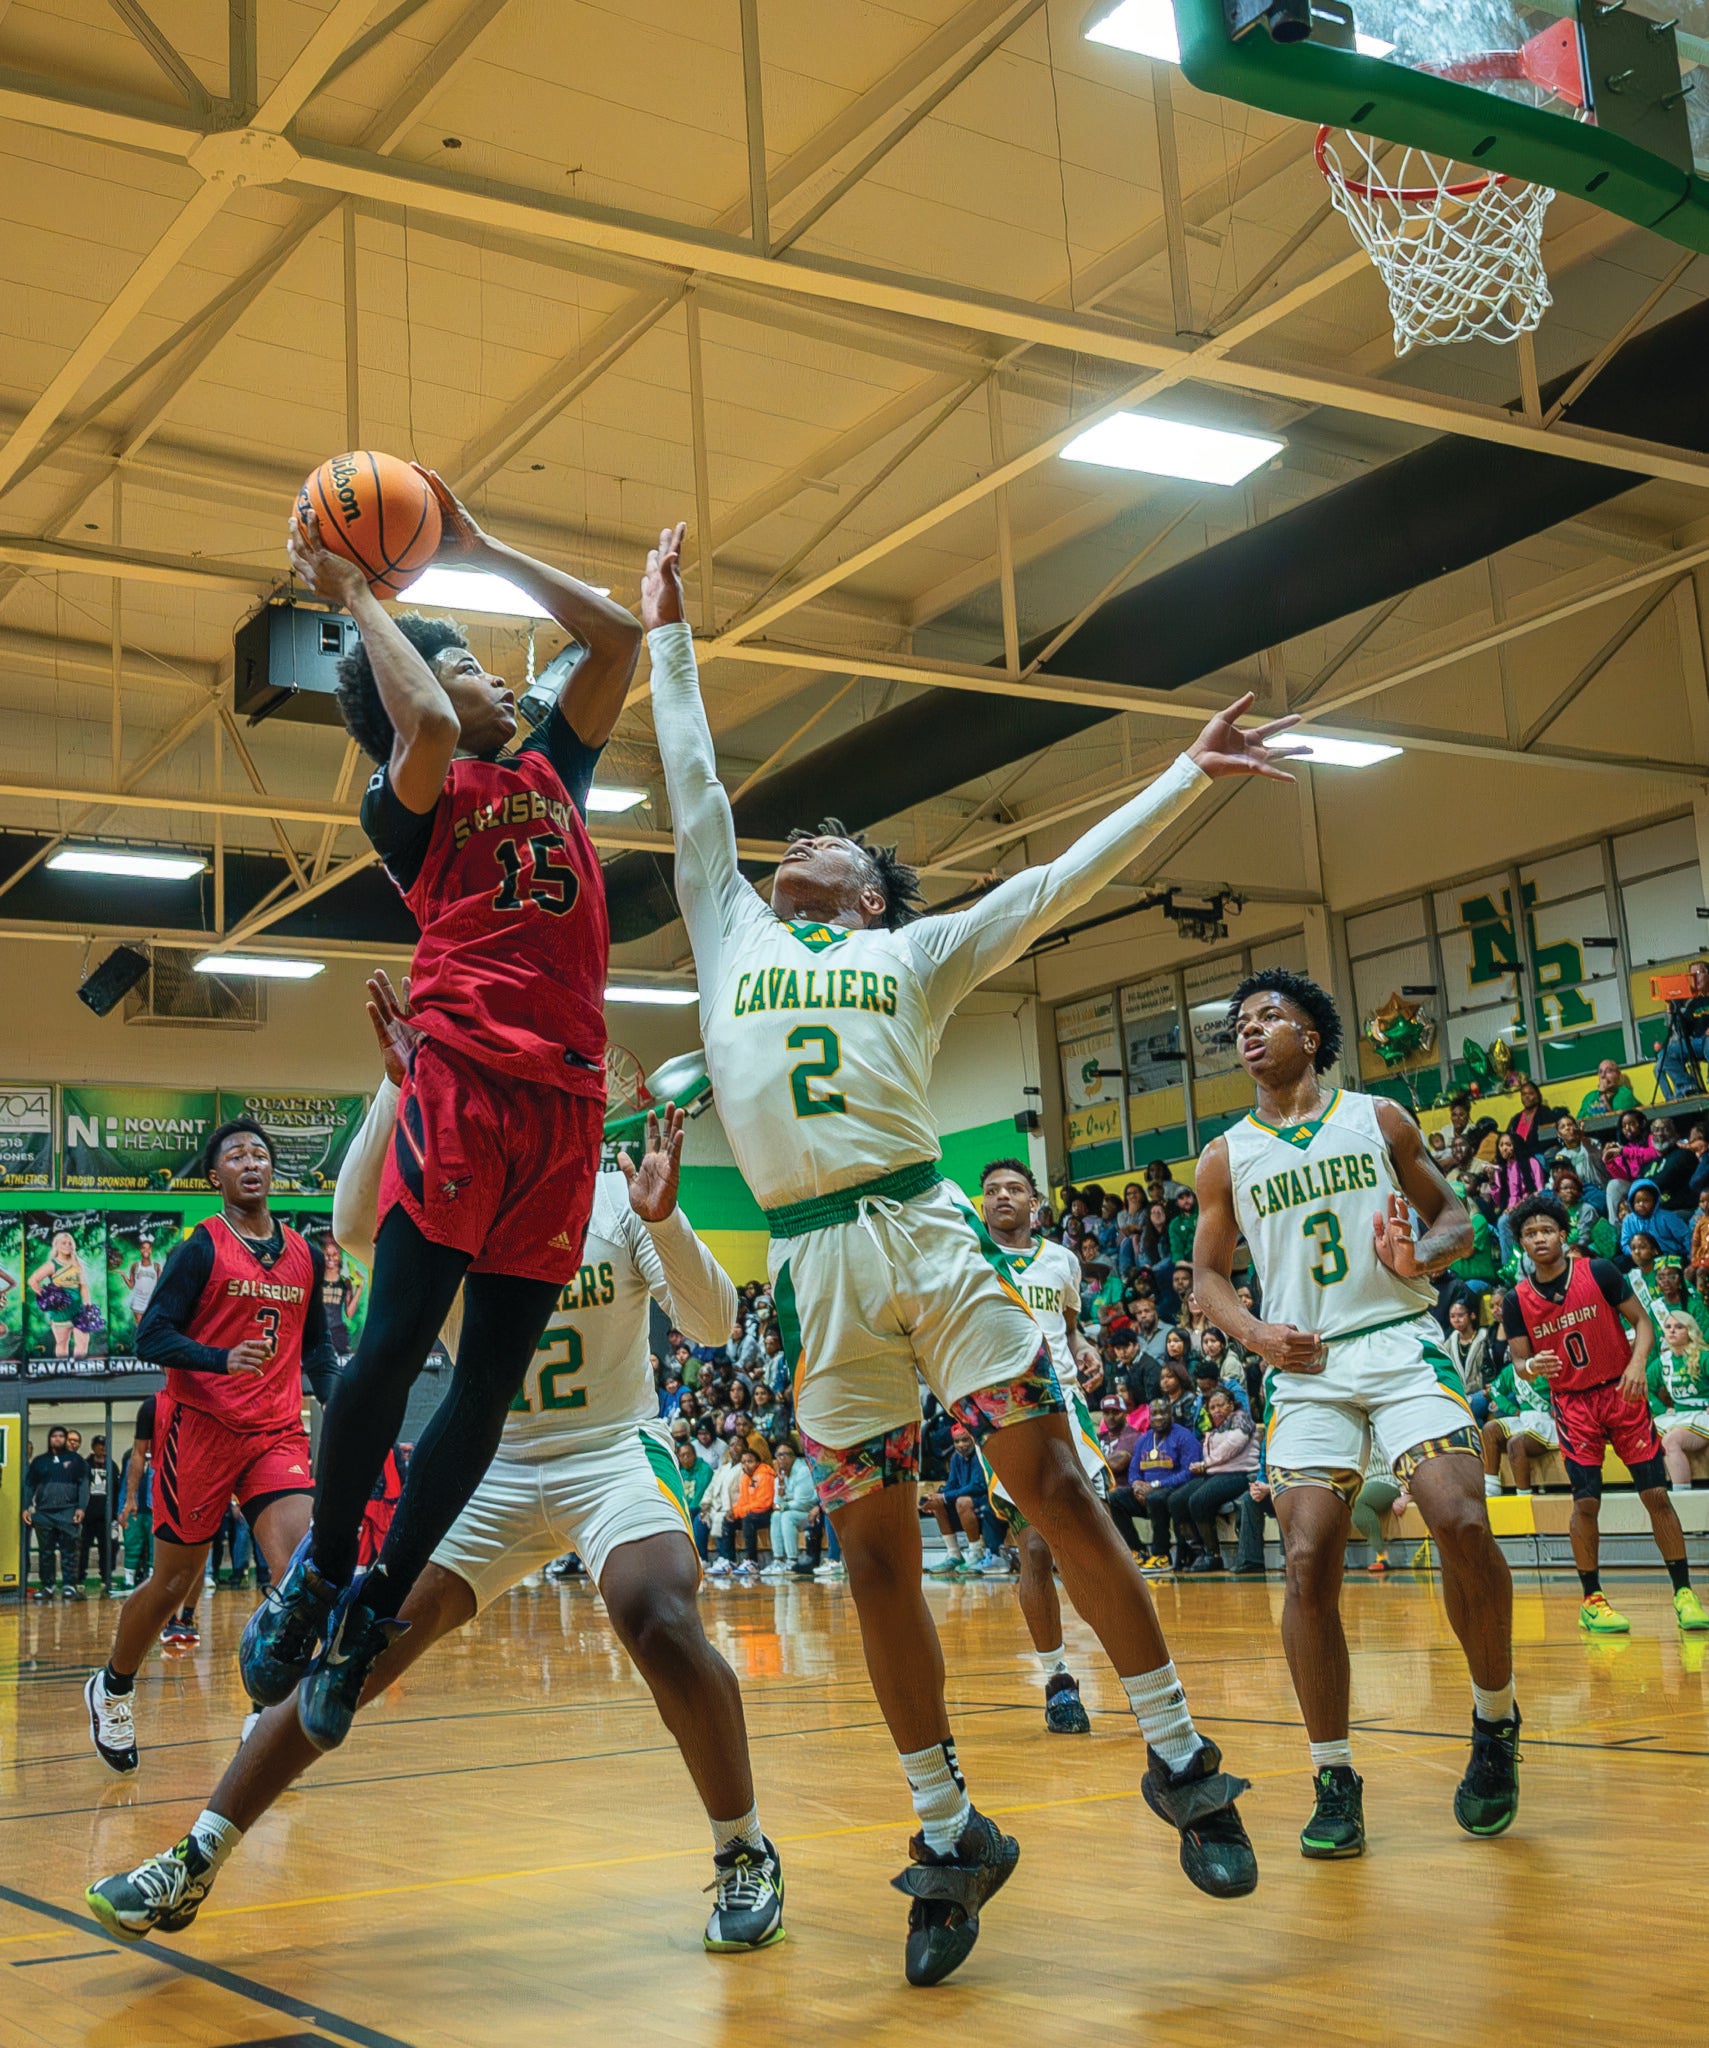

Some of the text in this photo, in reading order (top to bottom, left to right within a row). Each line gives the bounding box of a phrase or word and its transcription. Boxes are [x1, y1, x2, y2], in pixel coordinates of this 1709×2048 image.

[492, 831, 580, 917] 15
[733, 966, 899, 1018] CAVALIERS
[785, 1023, 848, 1120] 2
[125, 1117, 204, 1134] NOVANT
[125, 1134, 198, 1150] HEALTH
[4, 1174, 48, 1185] ATHLETICS
[66, 1175, 95, 1186] PROUD
[97, 1176, 136, 1187] SPONSOR
[137, 1177, 149, 1188] OF
[1250, 1152, 1378, 1219] CAVALIERS
[1302, 1208, 1350, 1289] 3
[557, 1261, 615, 1312] ERS
[256, 1306, 281, 1357] 3
[1532, 1304, 1598, 1340] SALISBURY
[28, 1361, 105, 1375] CAVALIERS
[508, 1325, 588, 1415] 2
[1562, 1330, 1590, 1369] 0
